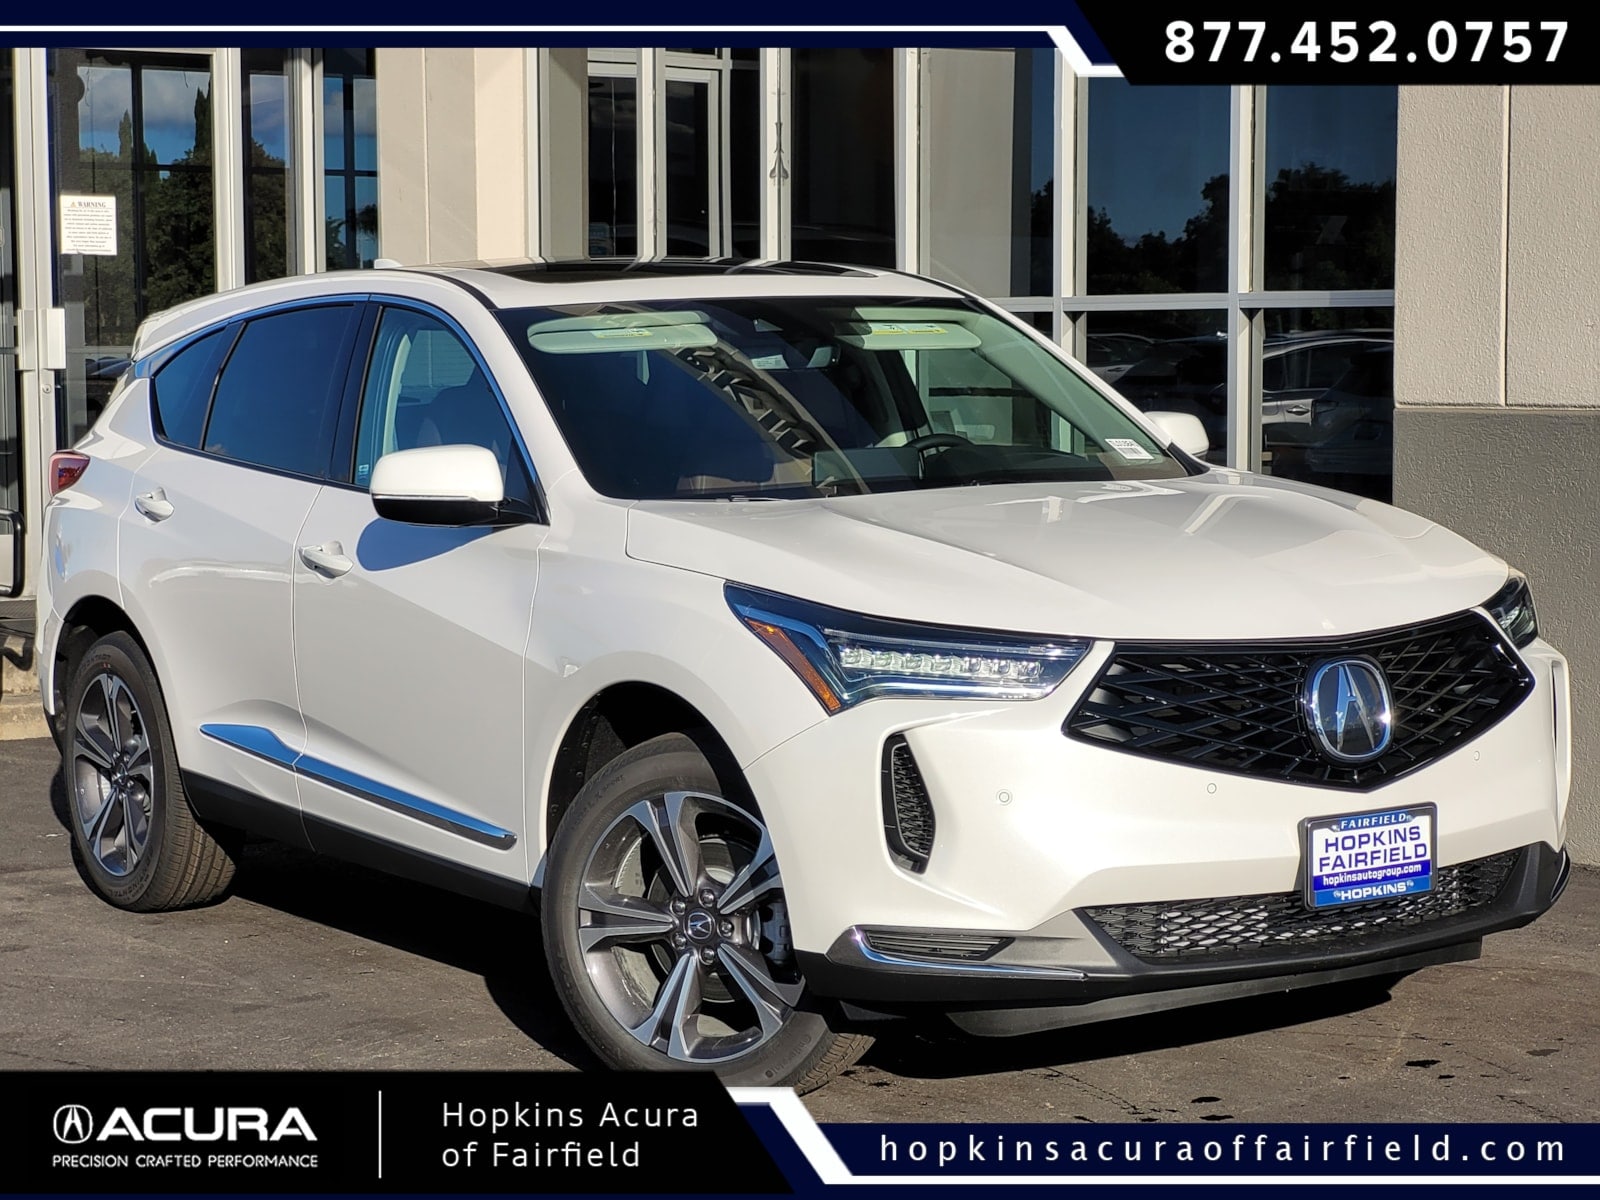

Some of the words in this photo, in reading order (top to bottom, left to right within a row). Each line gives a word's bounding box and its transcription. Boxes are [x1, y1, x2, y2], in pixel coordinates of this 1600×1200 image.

[1341, 812, 1407, 830] FAIRFIELD
[1324, 825, 1421, 853] HOPKINS
[1319, 843, 1428, 872] FAIRFIELD
[1322, 863, 1422, 887] hopkinsautogroup.com
[1340, 882, 1407, 901] HOPKINS
